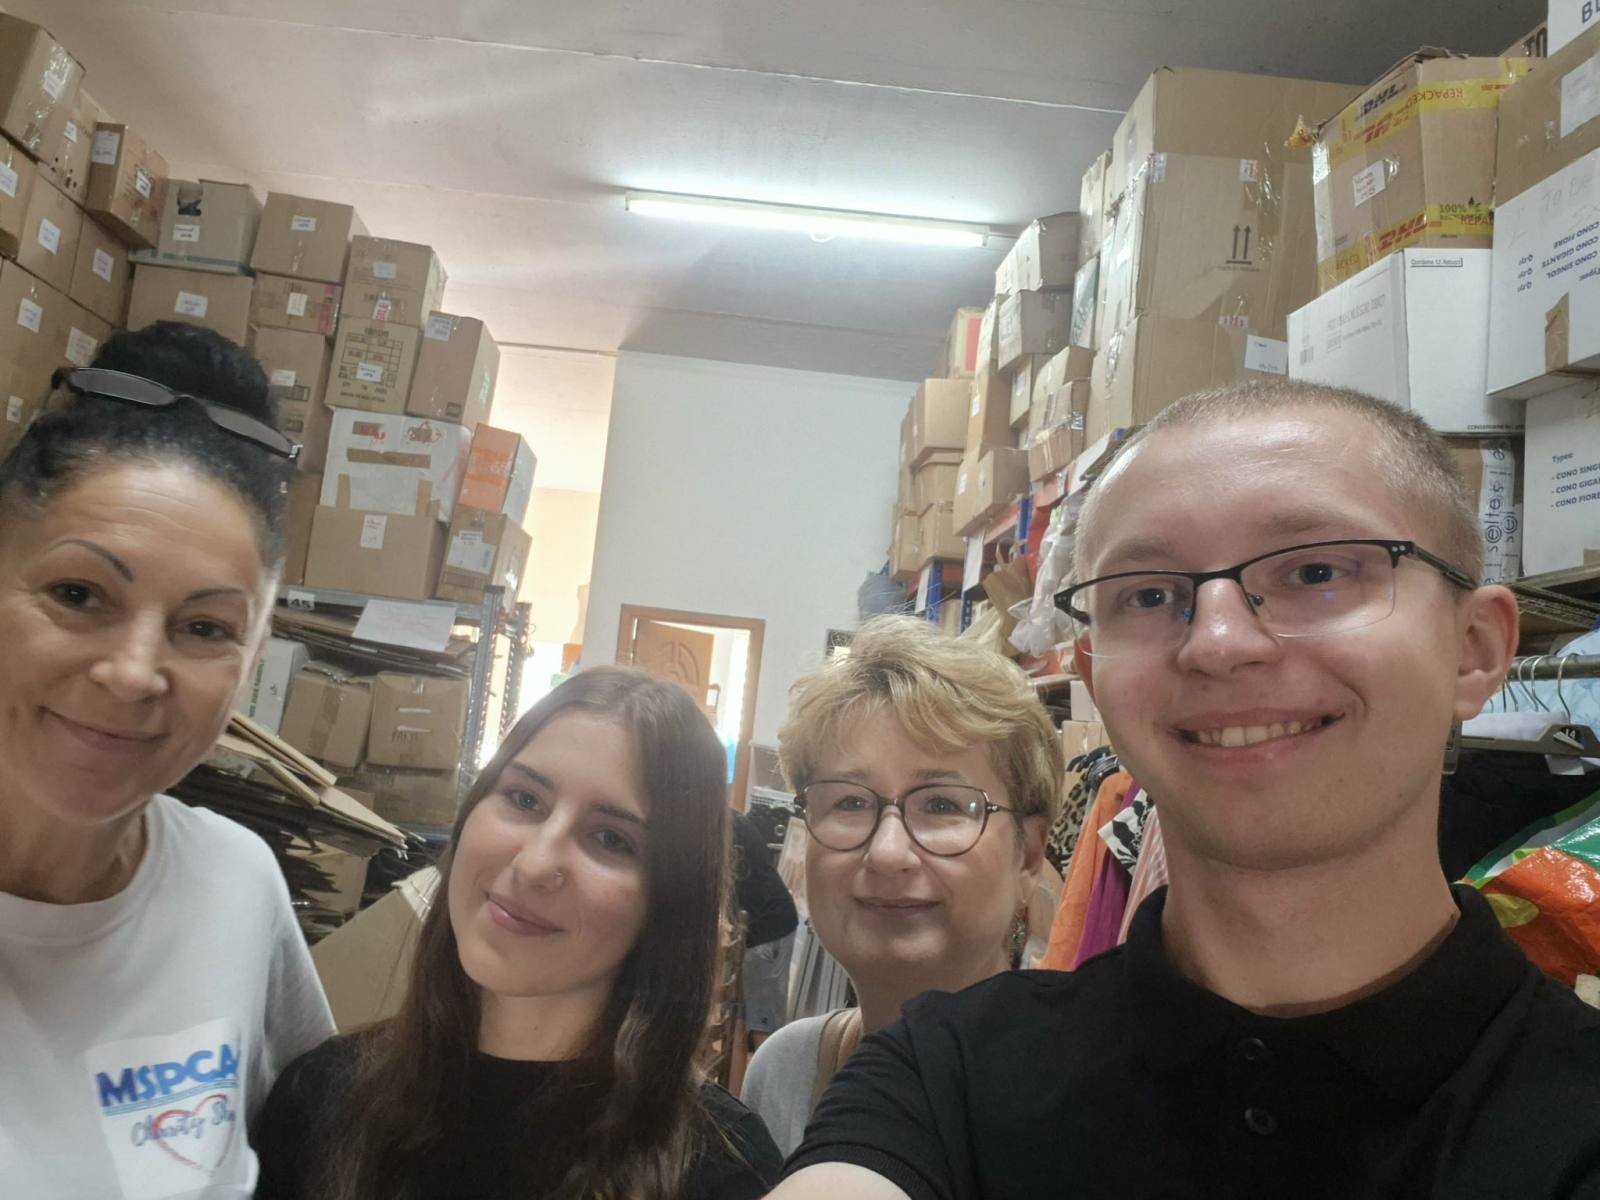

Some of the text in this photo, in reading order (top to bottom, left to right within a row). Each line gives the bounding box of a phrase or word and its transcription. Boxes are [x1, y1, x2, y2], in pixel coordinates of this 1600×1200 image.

[1461, 213, 1494, 226] REPA
[1576, 221, 1600, 238] CONO
[1575, 235, 1599, 252] CONO
[1575, 250, 1599, 267] CONO
[1556, 463, 1600, 480] CONO SING
[1556, 482, 1578, 494] CONO
[1555, 496, 1578, 508] CONO
[96, 1043, 239, 1107] MSPCA
